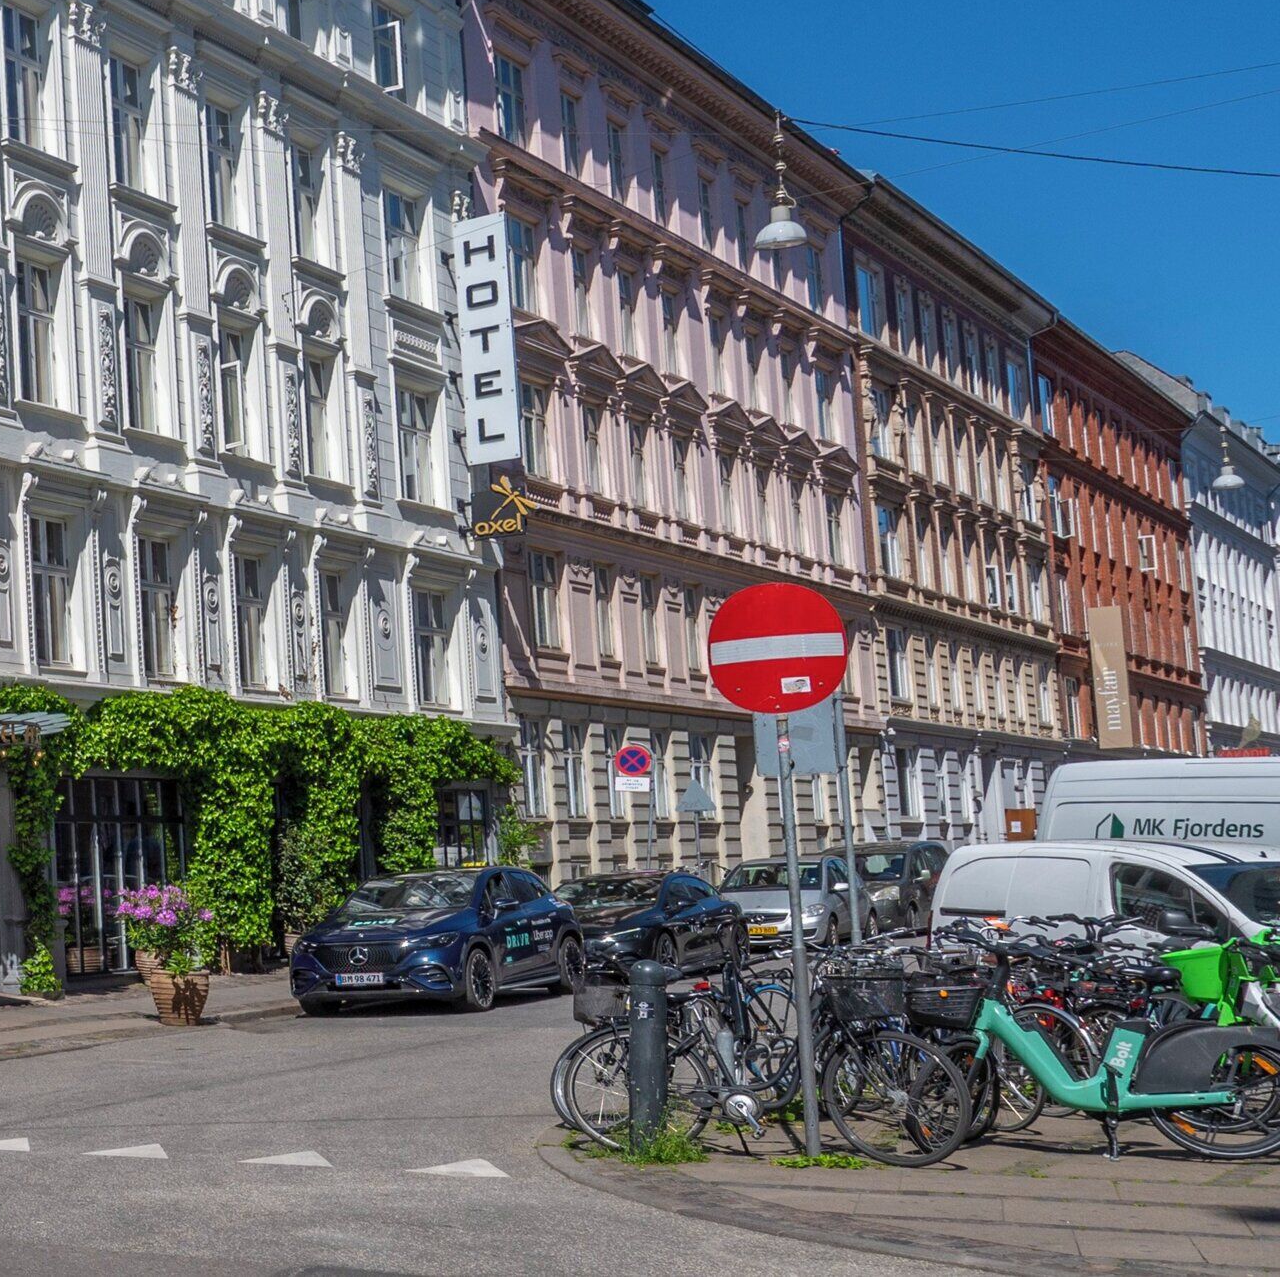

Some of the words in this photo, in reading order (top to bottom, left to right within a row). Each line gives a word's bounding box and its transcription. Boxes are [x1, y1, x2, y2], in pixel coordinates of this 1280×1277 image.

[463, 235, 505, 443] HOTEL
[474, 512, 523, 536] axel
[1097, 666, 1127, 730] mayfair
[1132, 818, 1166, 836] MK
[1173, 818, 1264, 839] Fjordens
[354, 975, 364, 983] 98
[366, 974, 381, 982] 471
[1109, 1041, 1133, 1068] Bolt
